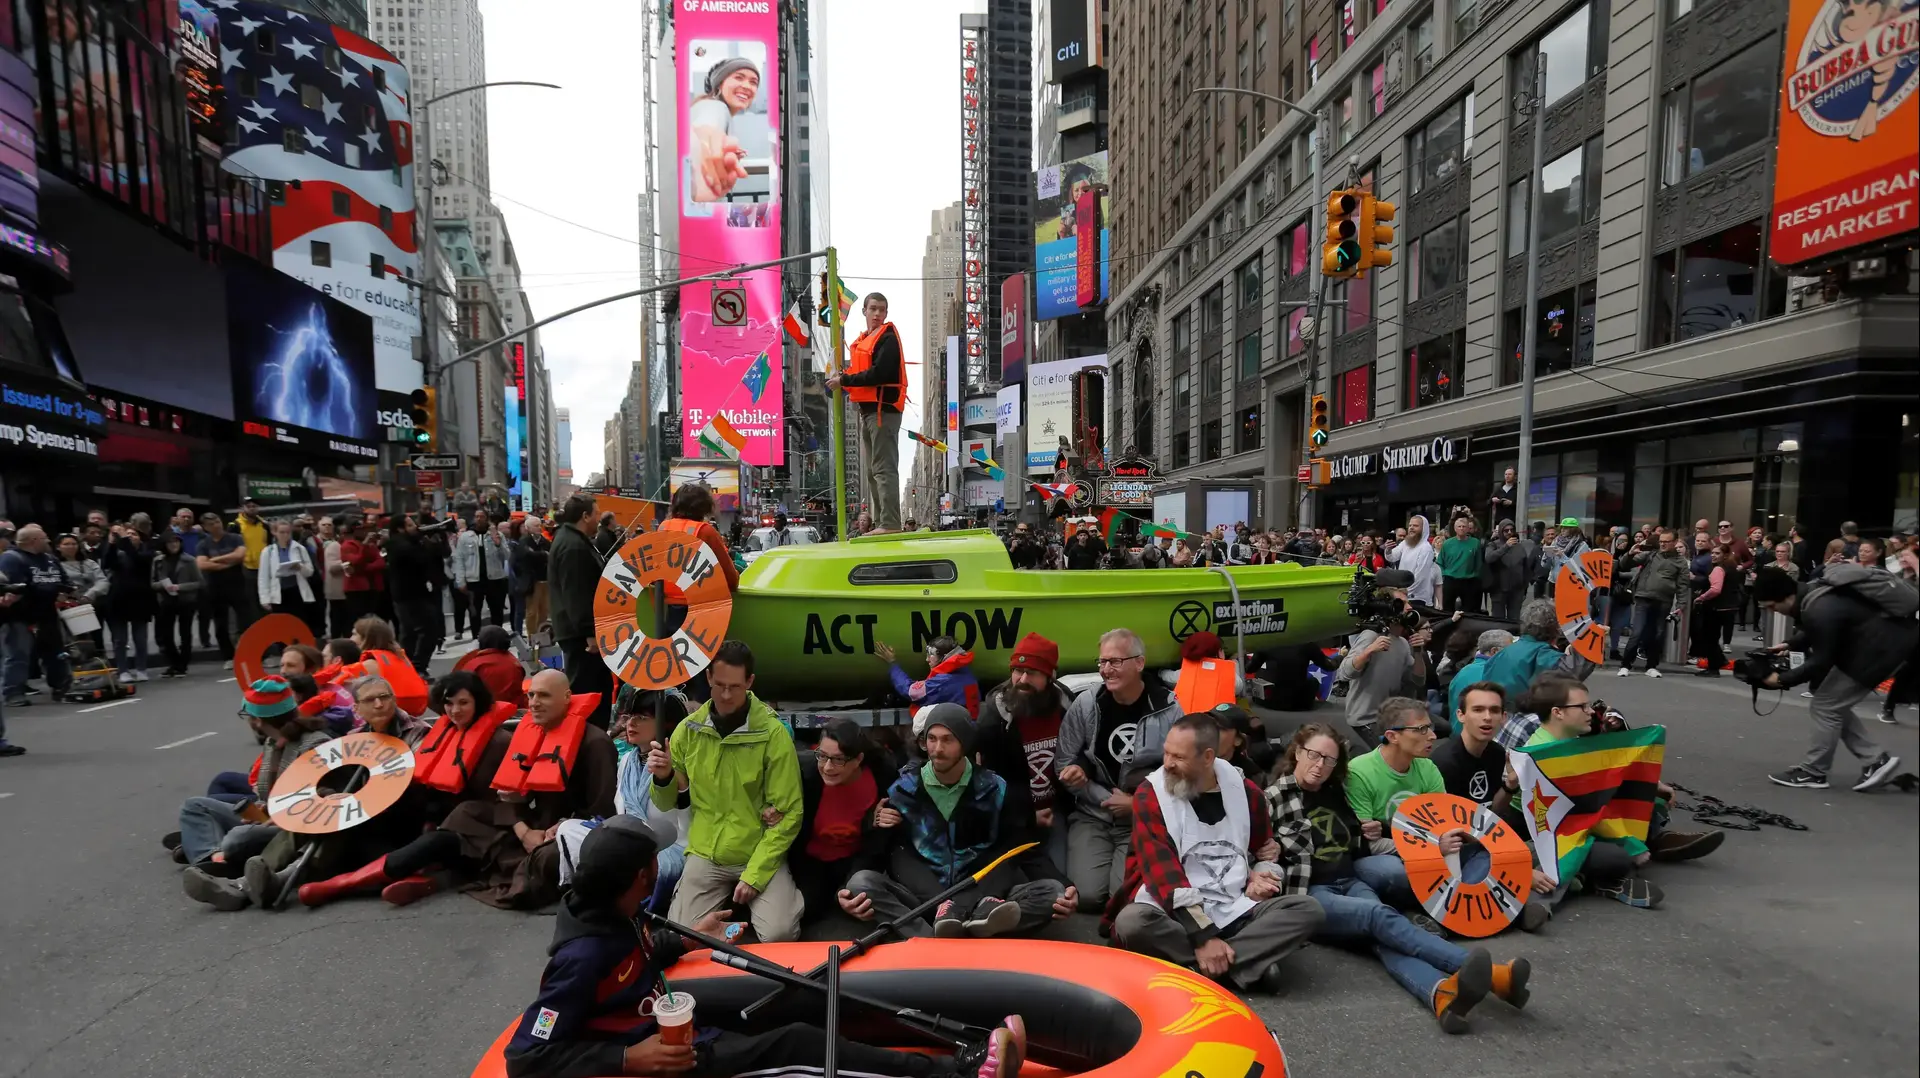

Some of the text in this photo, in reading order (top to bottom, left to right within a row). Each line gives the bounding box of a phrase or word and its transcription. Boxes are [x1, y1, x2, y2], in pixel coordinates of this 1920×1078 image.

[684, 1, 770, 13] OF AMERICANS
[1057, 40, 1081, 62] citi
[1795, 40, 1870, 100] BUBBA
[1814, 70, 1871, 108] SHRIMP
[1801, 199, 1912, 248] MARKET
[336, 280, 361, 300] for
[966, 232, 981, 356] YOUNG
[3, 384, 52, 412] issued
[54, 397, 73, 416] for
[26, 424, 75, 451] Spence
[74, 434, 86, 453] in
[329, 440, 378, 458] RAISING DION
[1382, 444, 1429, 471] SHRIMP
[1342, 454, 1369, 477] GUMP
[606, 542, 714, 606] SAVE OUR
[1568, 560, 1610, 590] SAVE
[803, 608, 1023, 654] ACT NOW
[600, 618, 719, 684] SHORE
[309, 740, 407, 780] SAVE OUR
[275, 784, 363, 826] YOUTH
[1403, 802, 1505, 848] SAVE OUR
[1428, 871, 1520, 921] FUTURE
[534, 1029, 547, 1037] LFP
